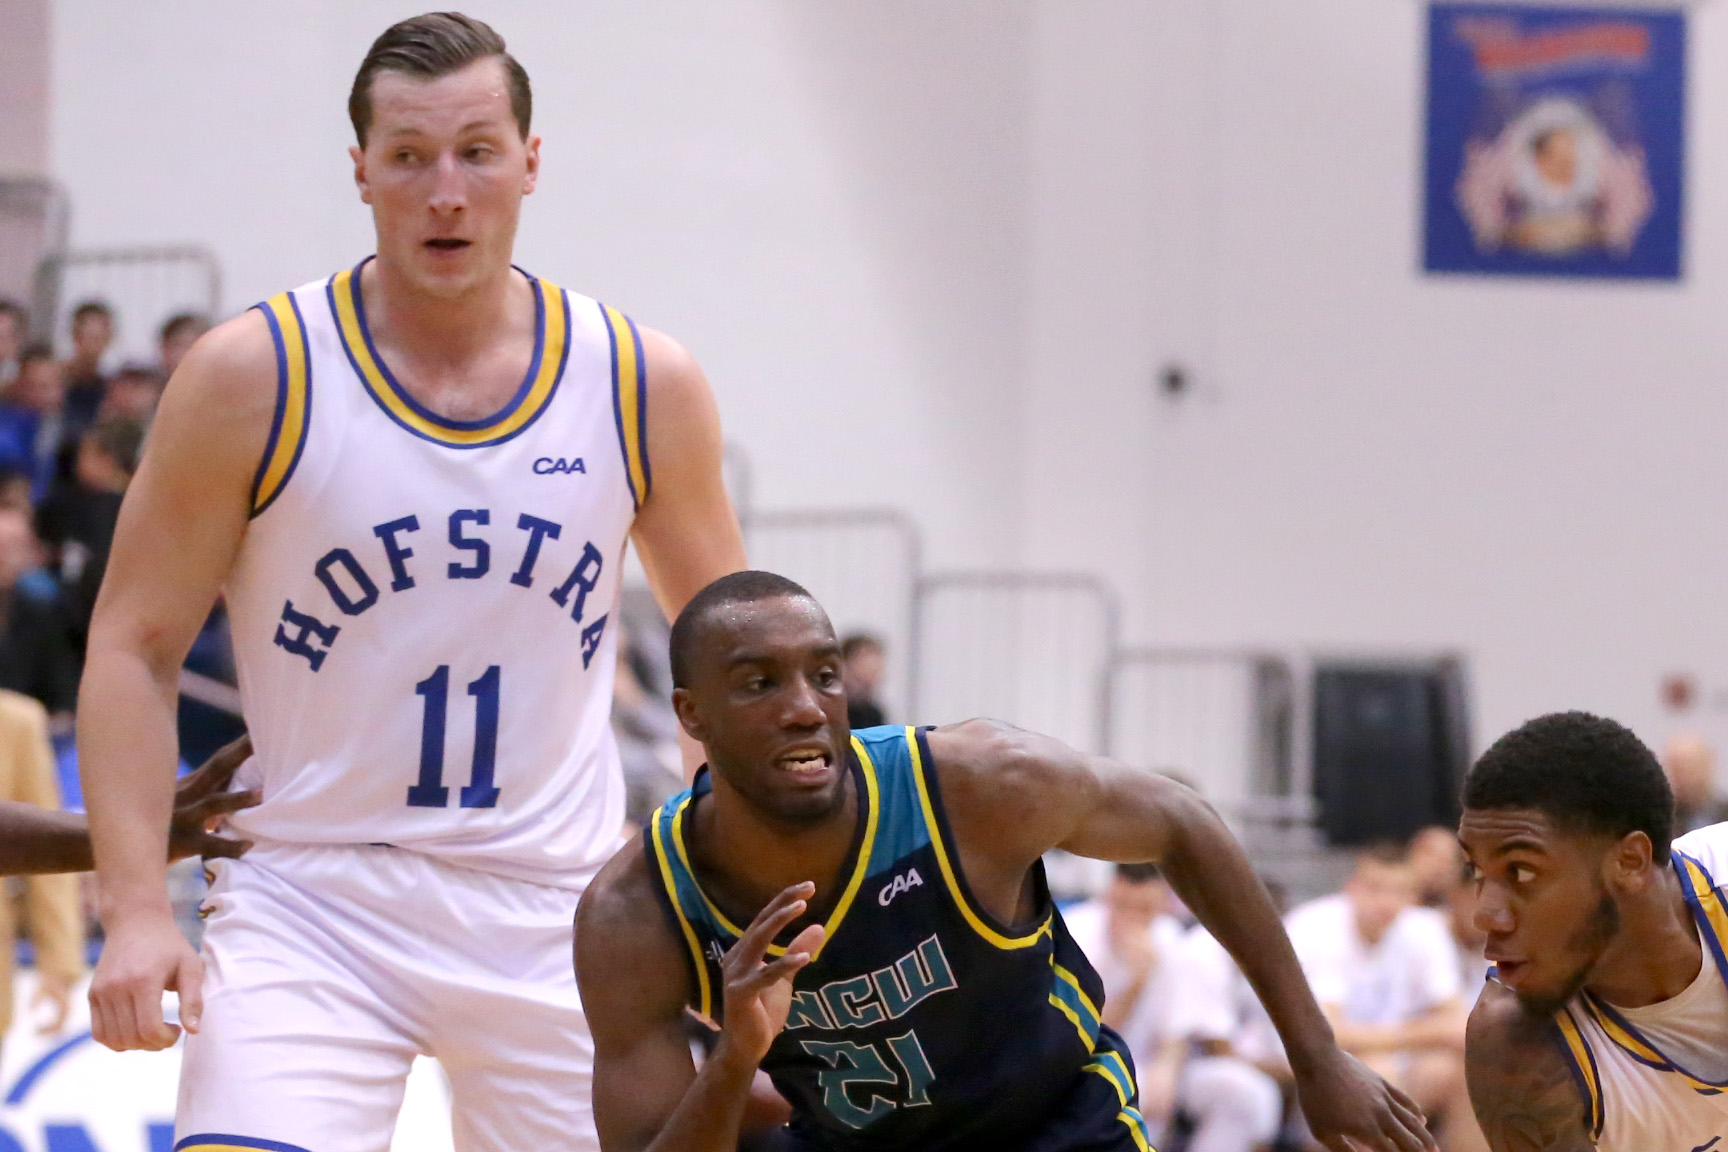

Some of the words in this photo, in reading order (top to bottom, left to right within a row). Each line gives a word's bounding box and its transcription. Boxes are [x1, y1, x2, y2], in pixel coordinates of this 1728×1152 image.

[532, 456, 587, 475] CAA
[273, 508, 610, 673] HOFSTRA
[406, 664, 502, 809] 11
[878, 868, 924, 907] CAA
[782, 932, 959, 1030] NCW
[800, 1028, 936, 1130] 21
